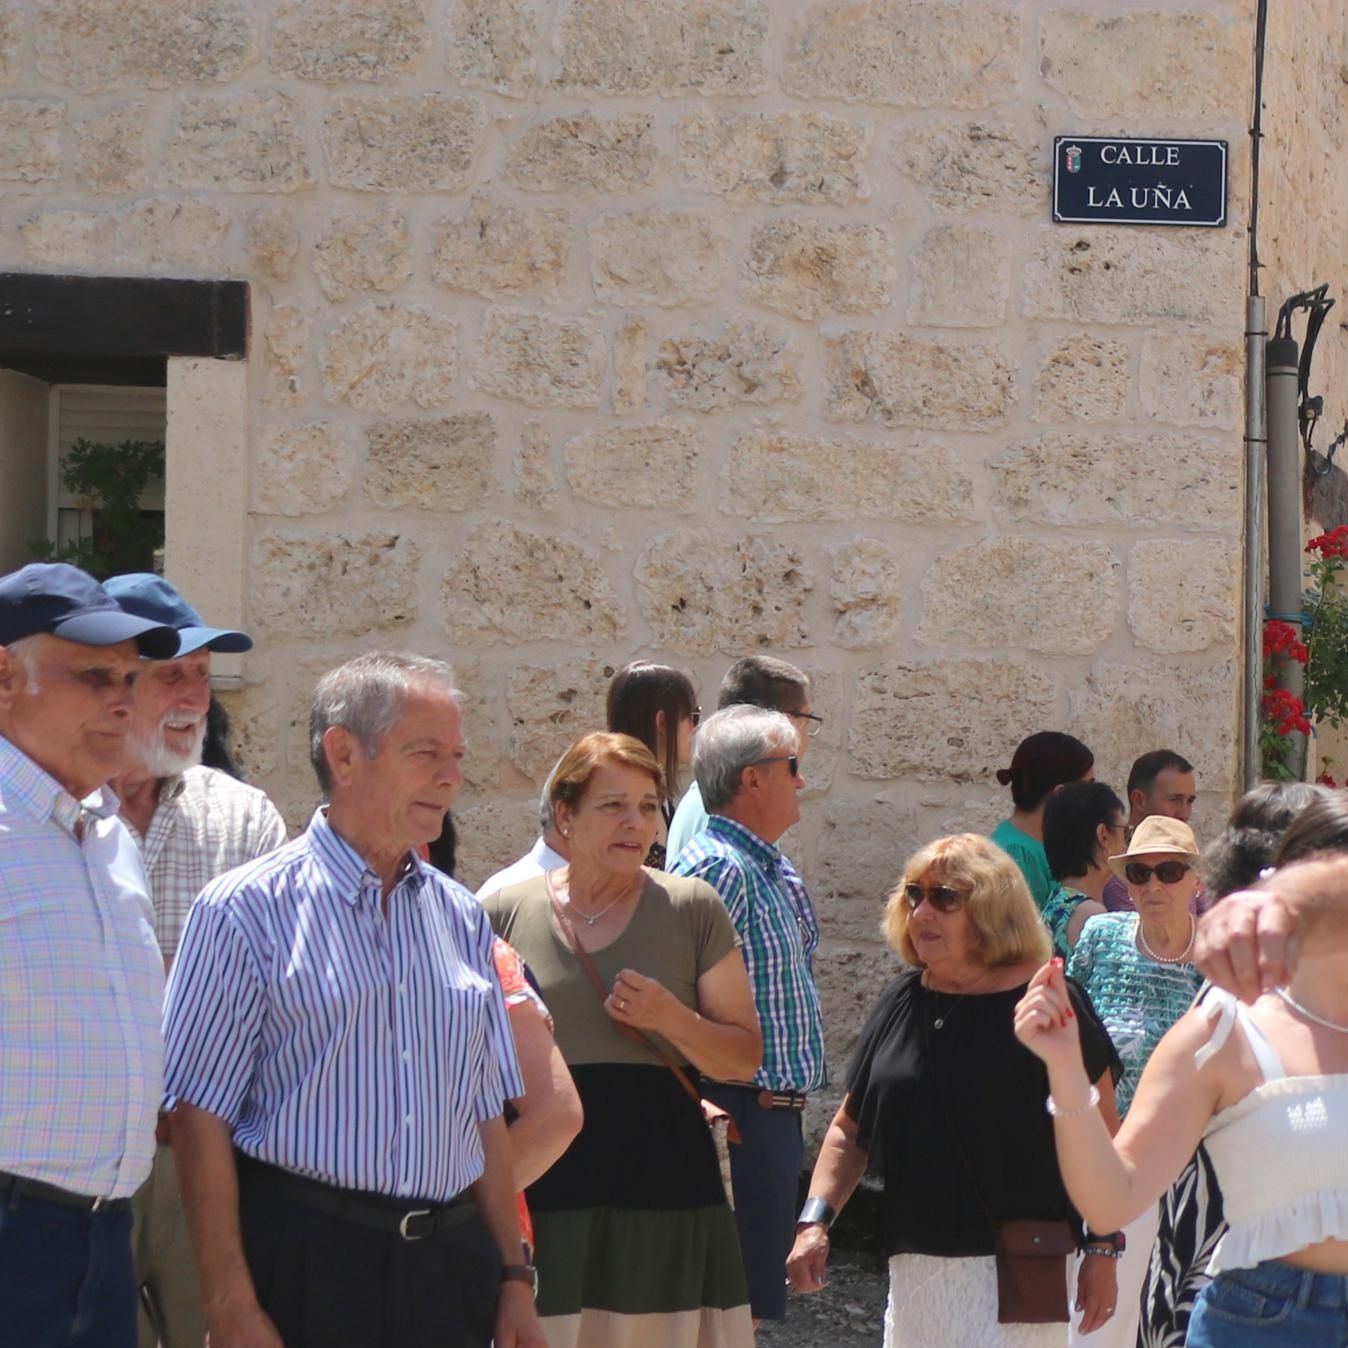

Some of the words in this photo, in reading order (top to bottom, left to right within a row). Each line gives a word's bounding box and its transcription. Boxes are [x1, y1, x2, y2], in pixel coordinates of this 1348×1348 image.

[1100, 145, 1181, 166] CALLE
[1087, 186, 1124, 208] LA
[1130, 184, 1192, 210] UÑA
